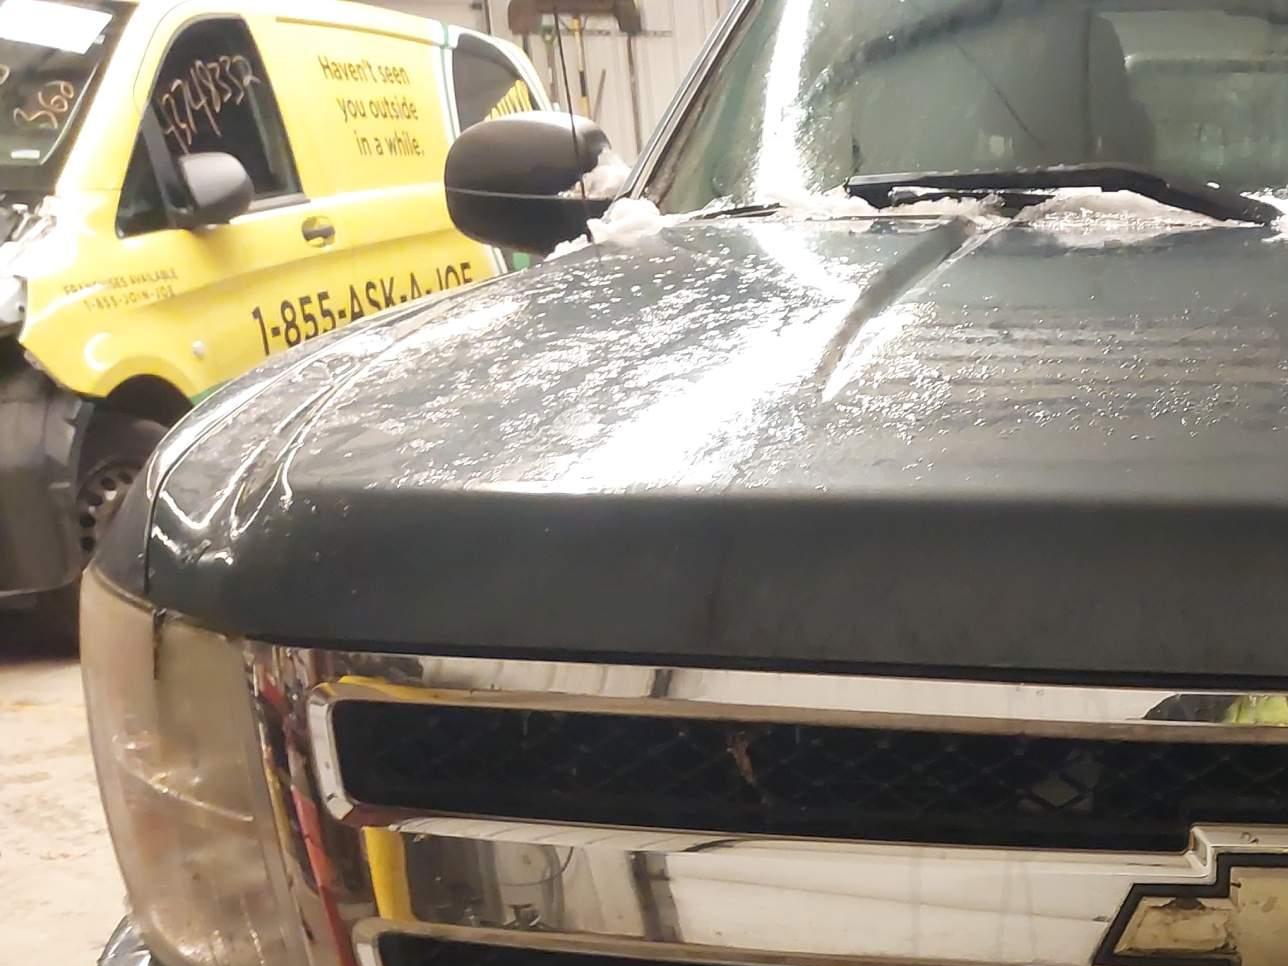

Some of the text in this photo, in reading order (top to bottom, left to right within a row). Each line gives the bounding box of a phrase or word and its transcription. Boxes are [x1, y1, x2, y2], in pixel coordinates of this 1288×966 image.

[317, 55, 410, 85] Haven't seen
[336, 96, 419, 124] you outside
[353, 129, 373, 156] in
[374, 137, 384, 156] a
[251, 262, 473, 356] 1-855-ASK-A-JOE
